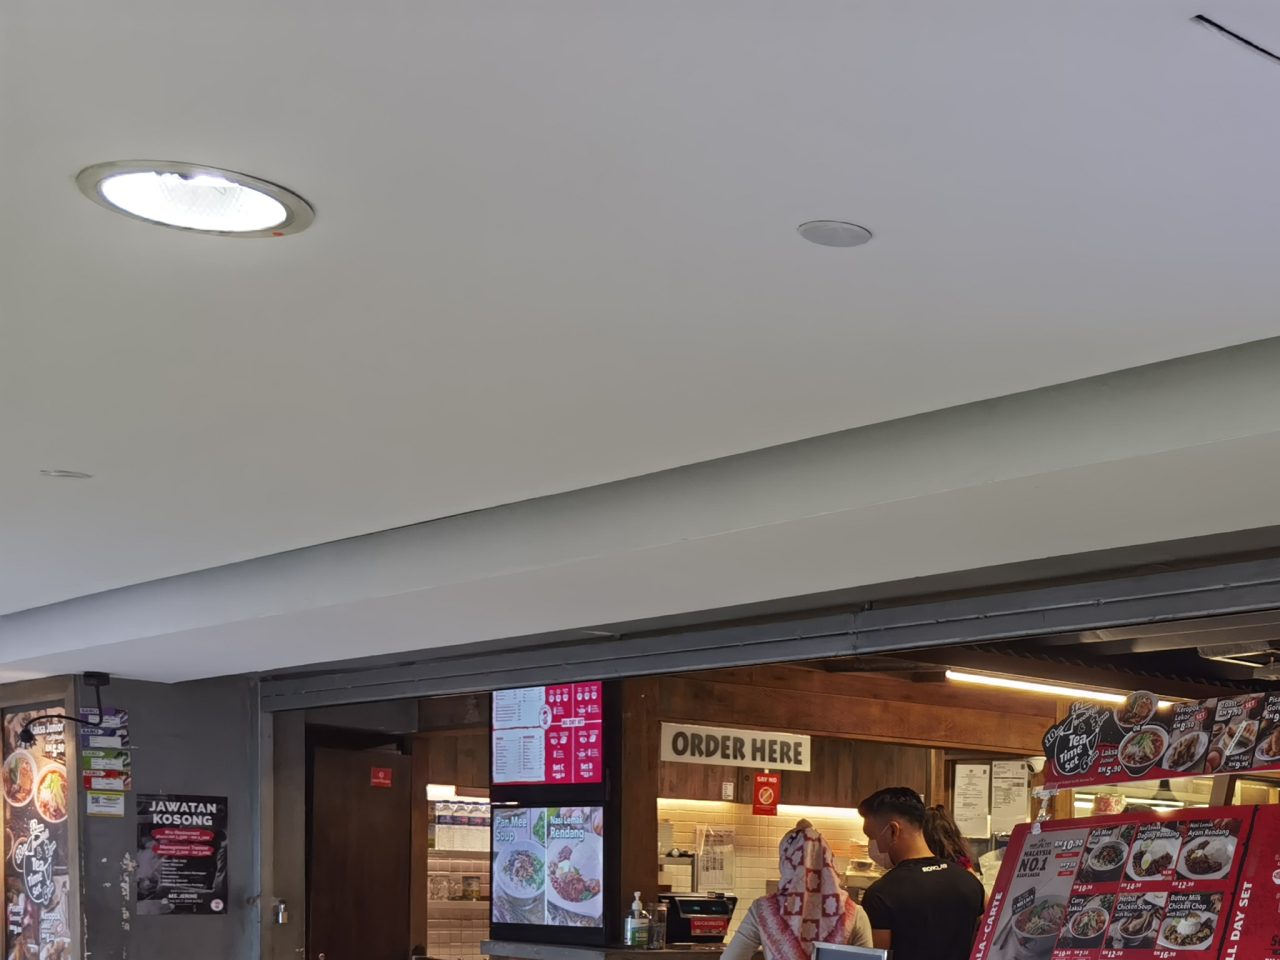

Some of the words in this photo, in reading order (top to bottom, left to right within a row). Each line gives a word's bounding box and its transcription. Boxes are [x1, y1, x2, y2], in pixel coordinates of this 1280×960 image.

[1245, 699, 1256, 709] SET
[1196, 711, 1206, 719] SET
[1068, 734, 1087, 747] Tea
[671, 730, 746, 761] ORDER
[751, 737, 803, 766] HERE
[1060, 744, 1083, 764] Time
[1064, 757, 1080, 772] Set
[1098, 765, 1122, 776] RM5.90
[149, 801, 217, 814] JAWATAN
[152, 813, 213, 826] KOSONG
[496, 817, 510, 828] Pan
[511, 816, 527, 828] Mee
[550, 816, 563, 825] Nasi
[563, 815, 583, 825] Lemak
[495, 831, 515, 844] Soup
[550, 826, 584, 841] Rendang
[1137, 831, 1156, 839] Daging
[1156, 831, 1180, 839] Rendang
[1188, 829, 1204, 837] Ayam
[1204, 828, 1230, 837] Rendang
[1023, 849, 1052, 857] MALAYSIA
[1018, 857, 1048, 873] NO.1
[1071, 897, 1084, 905] Curry
[1116, 903, 1138, 911] Chicken
[1138, 903, 1153, 911] Soup
[1191, 903, 1207, 911] Chop
[1230, 911, 1246, 941] DAY
[1239, 881, 1253, 907] SET
